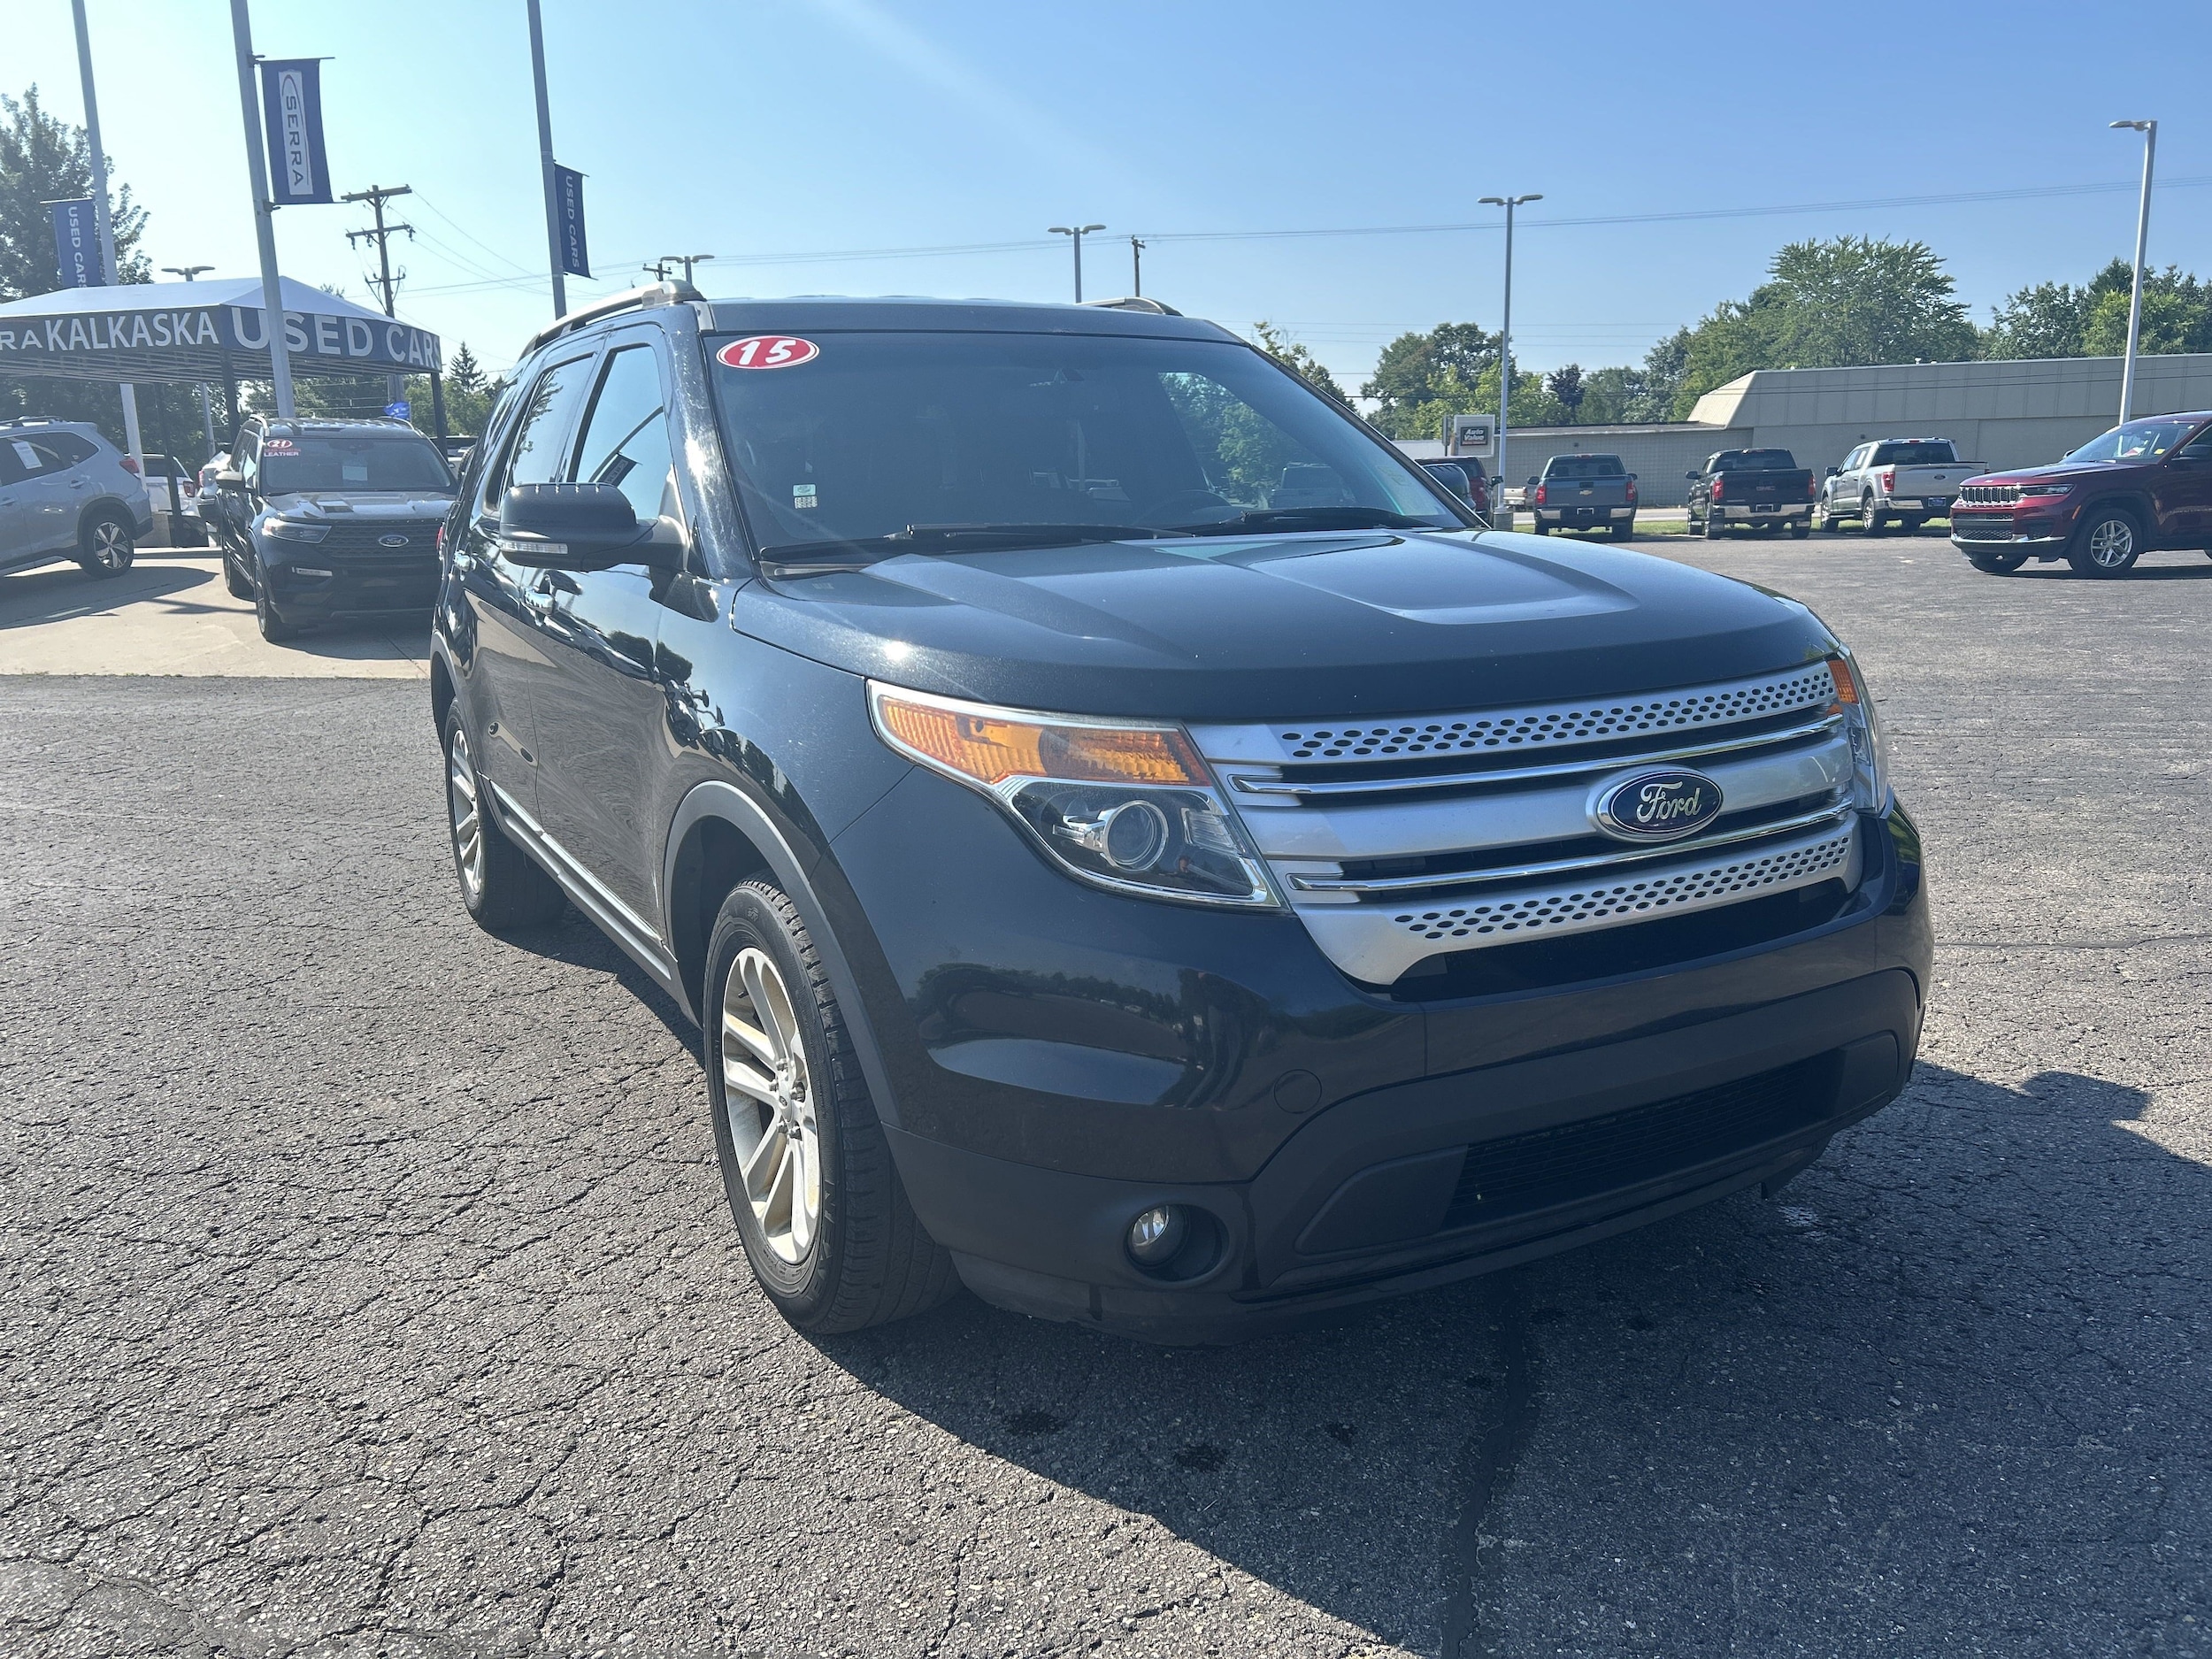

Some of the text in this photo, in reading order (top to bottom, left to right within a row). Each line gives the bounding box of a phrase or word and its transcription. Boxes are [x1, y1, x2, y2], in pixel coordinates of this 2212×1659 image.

[286, 96, 303, 186] SERRA
[68, 206, 81, 248] USED
[566, 175, 580, 268] USED CARS
[44, 311, 219, 351] KALKASKA
[232, 306, 442, 371] USED CARS
[739, 340, 796, 365] 15
[1636, 780, 1702, 823] Ford
